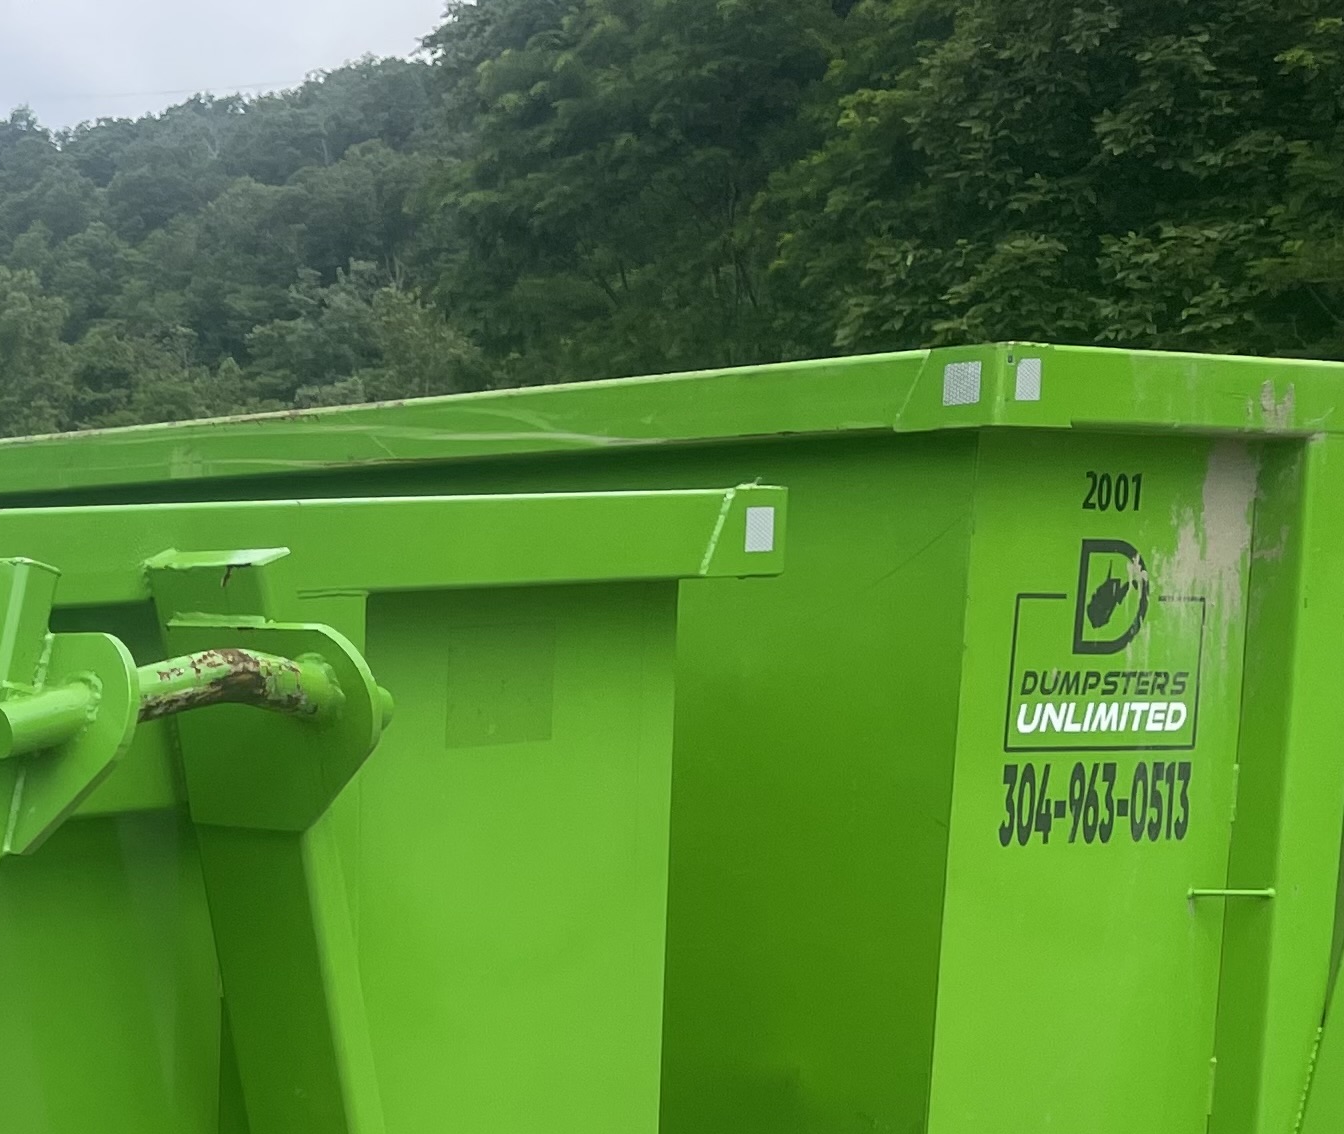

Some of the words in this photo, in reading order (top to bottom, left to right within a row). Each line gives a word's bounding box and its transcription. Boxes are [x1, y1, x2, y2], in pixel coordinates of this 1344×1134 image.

[1082, 471, 1143, 512] 2001
[1020, 671, 1190, 696] DUMPSTERS
[1016, 701, 1188, 734] UNLIMITED
[998, 760, 1192, 847] 304-963-0513
